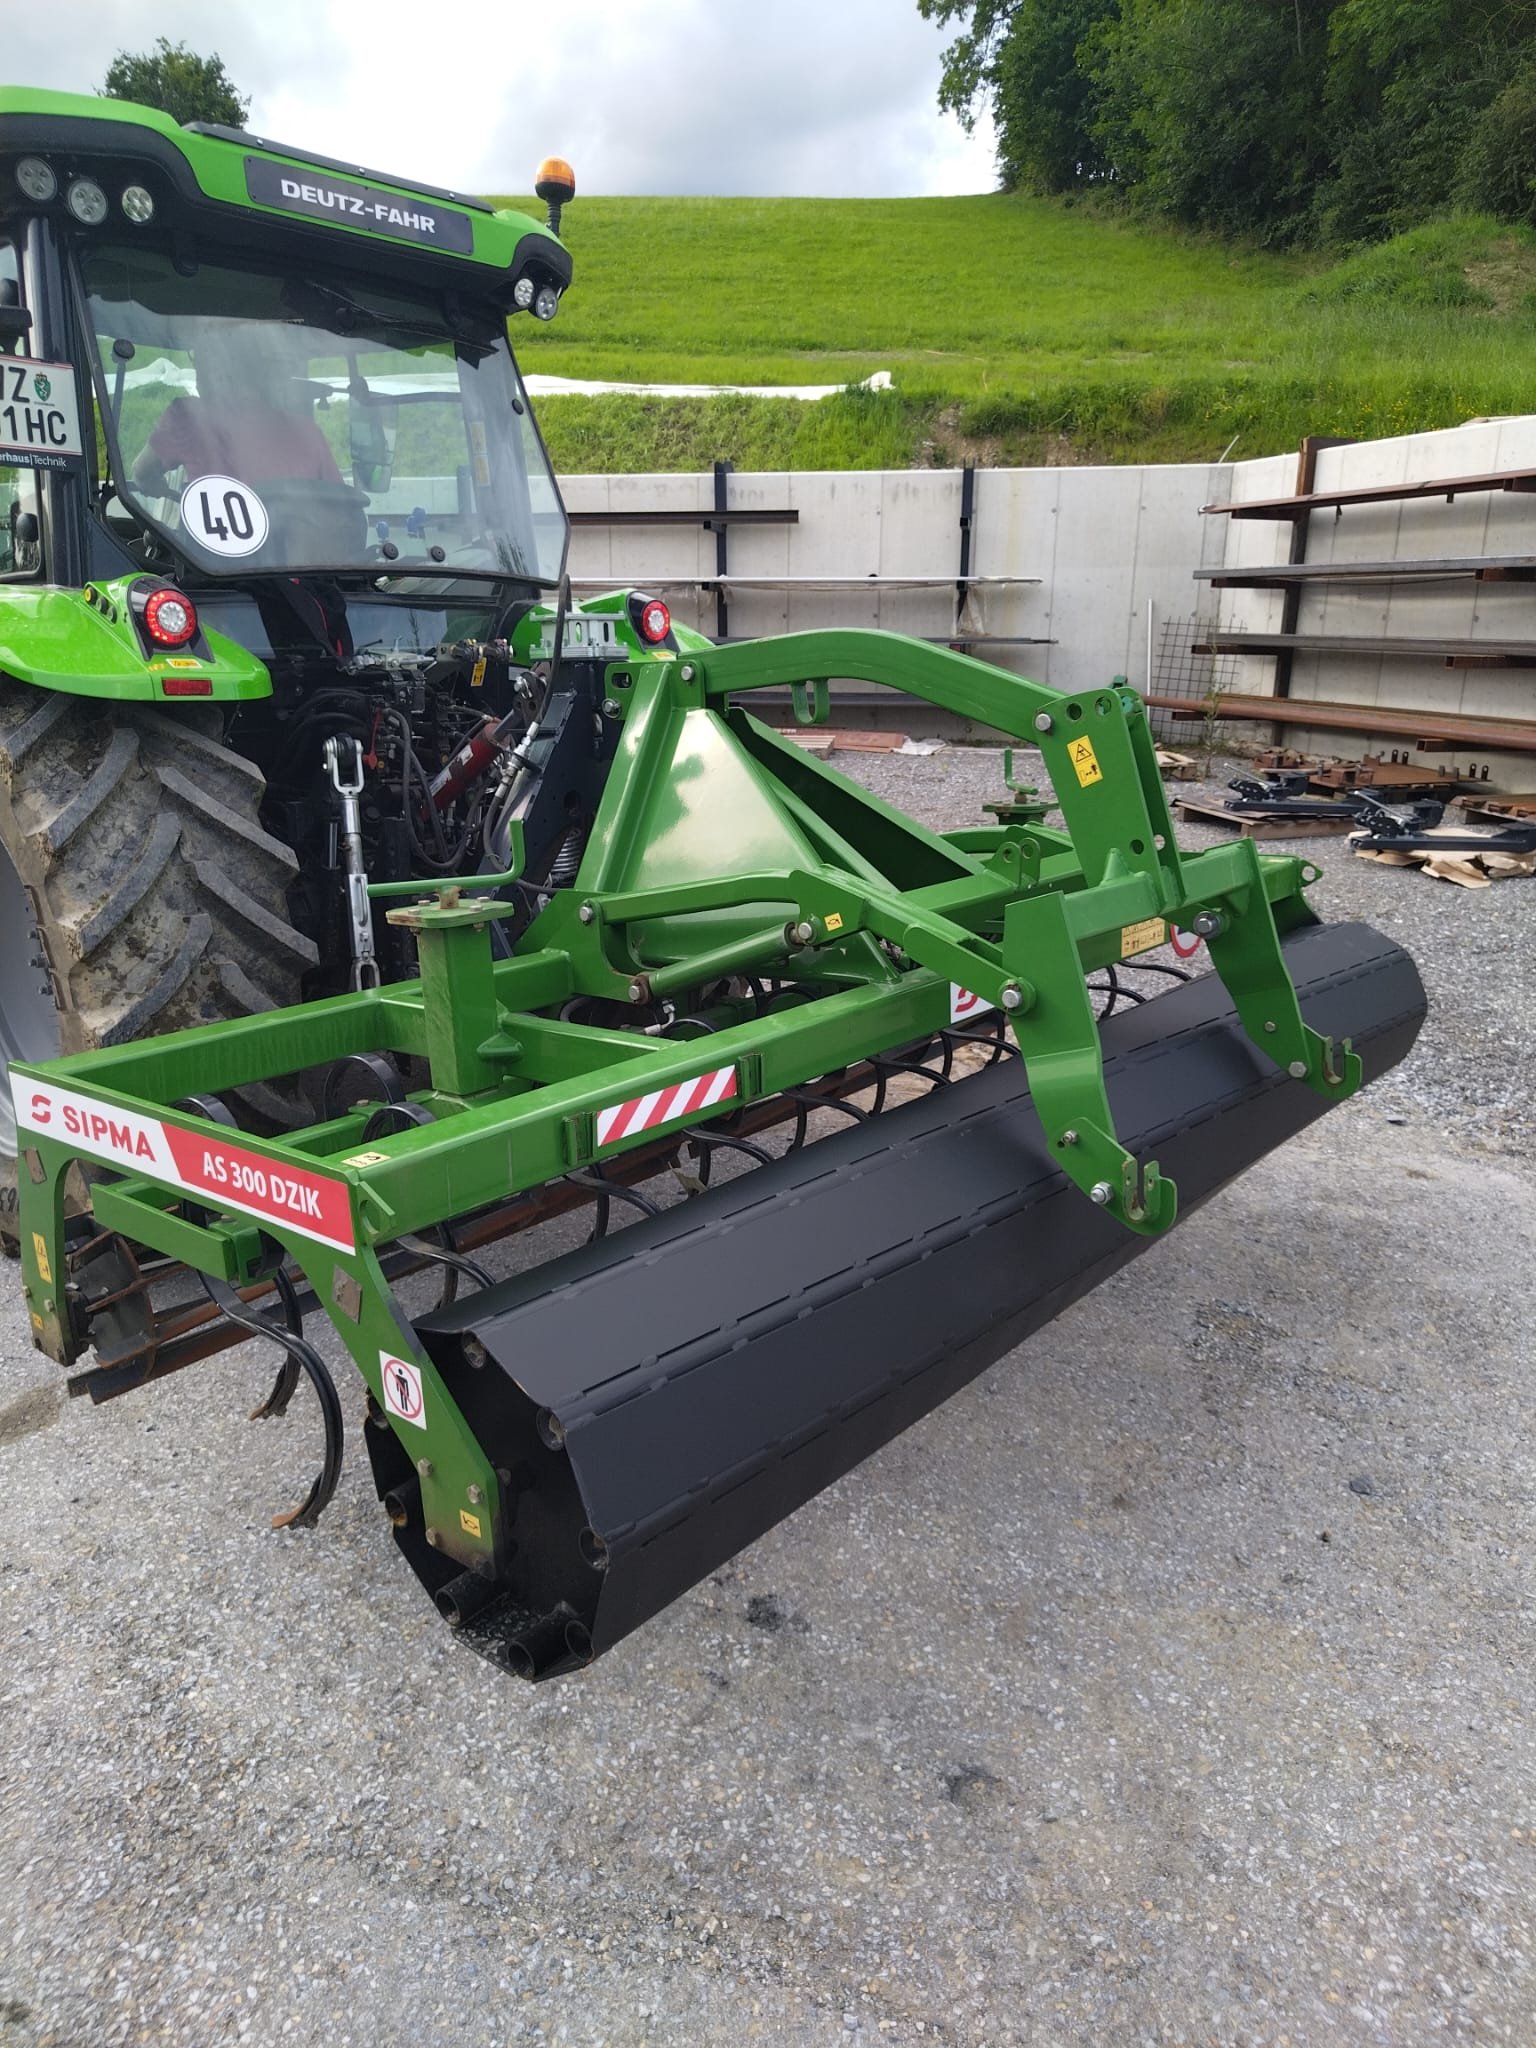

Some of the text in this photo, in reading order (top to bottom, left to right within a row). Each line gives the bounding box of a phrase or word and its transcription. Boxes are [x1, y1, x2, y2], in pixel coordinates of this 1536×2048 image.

[280, 178, 436, 234] DEUTZ-FAHR
[0, 364, 30, 403] Z
[199, 490, 254, 541] 40
[62, 1105, 157, 1163] SIPMA
[203, 1151, 323, 1220] AS 300 DZIK
